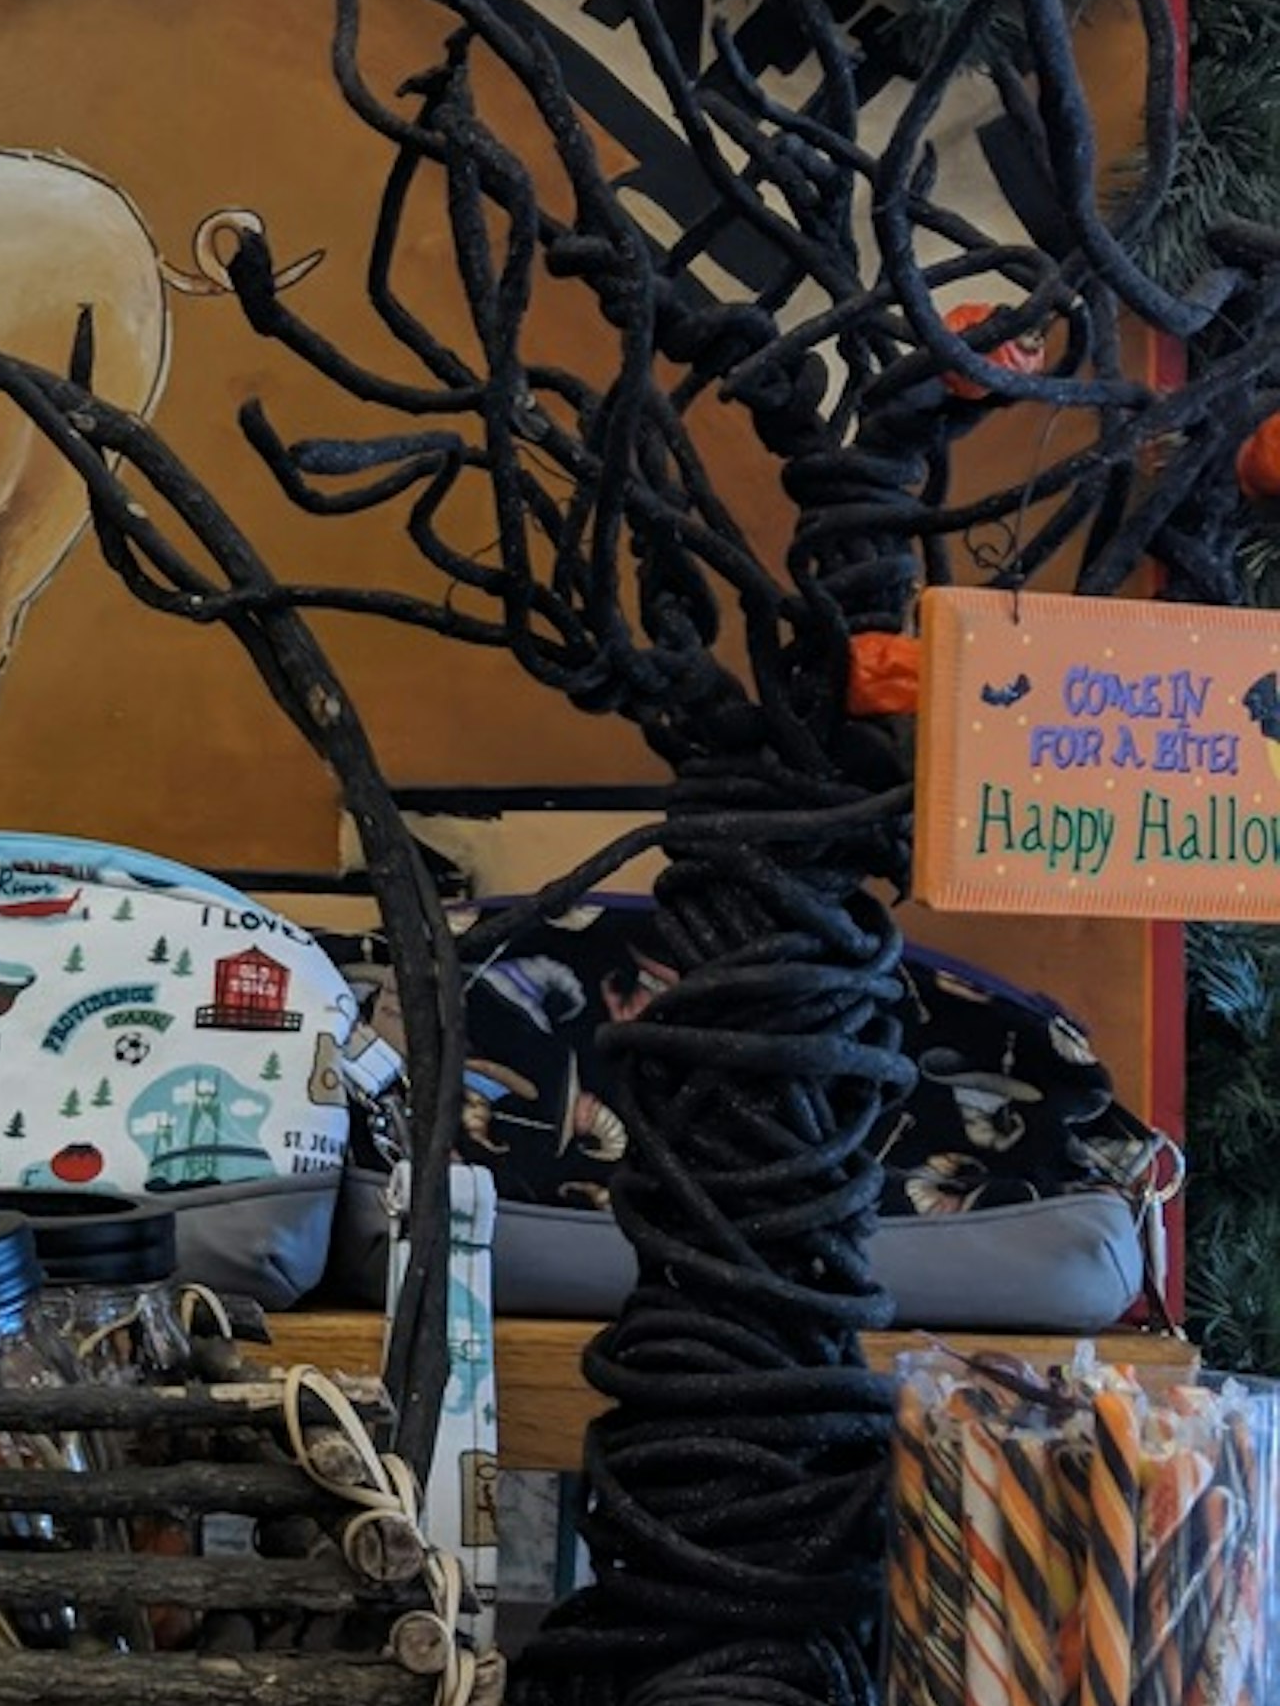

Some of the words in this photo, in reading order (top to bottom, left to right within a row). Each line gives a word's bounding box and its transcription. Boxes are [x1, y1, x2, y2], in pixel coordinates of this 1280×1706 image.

[1030, 725, 1103, 770] FOR
[1112, 726, 1146, 769] A
[976, 783, 1116, 875] Happy
